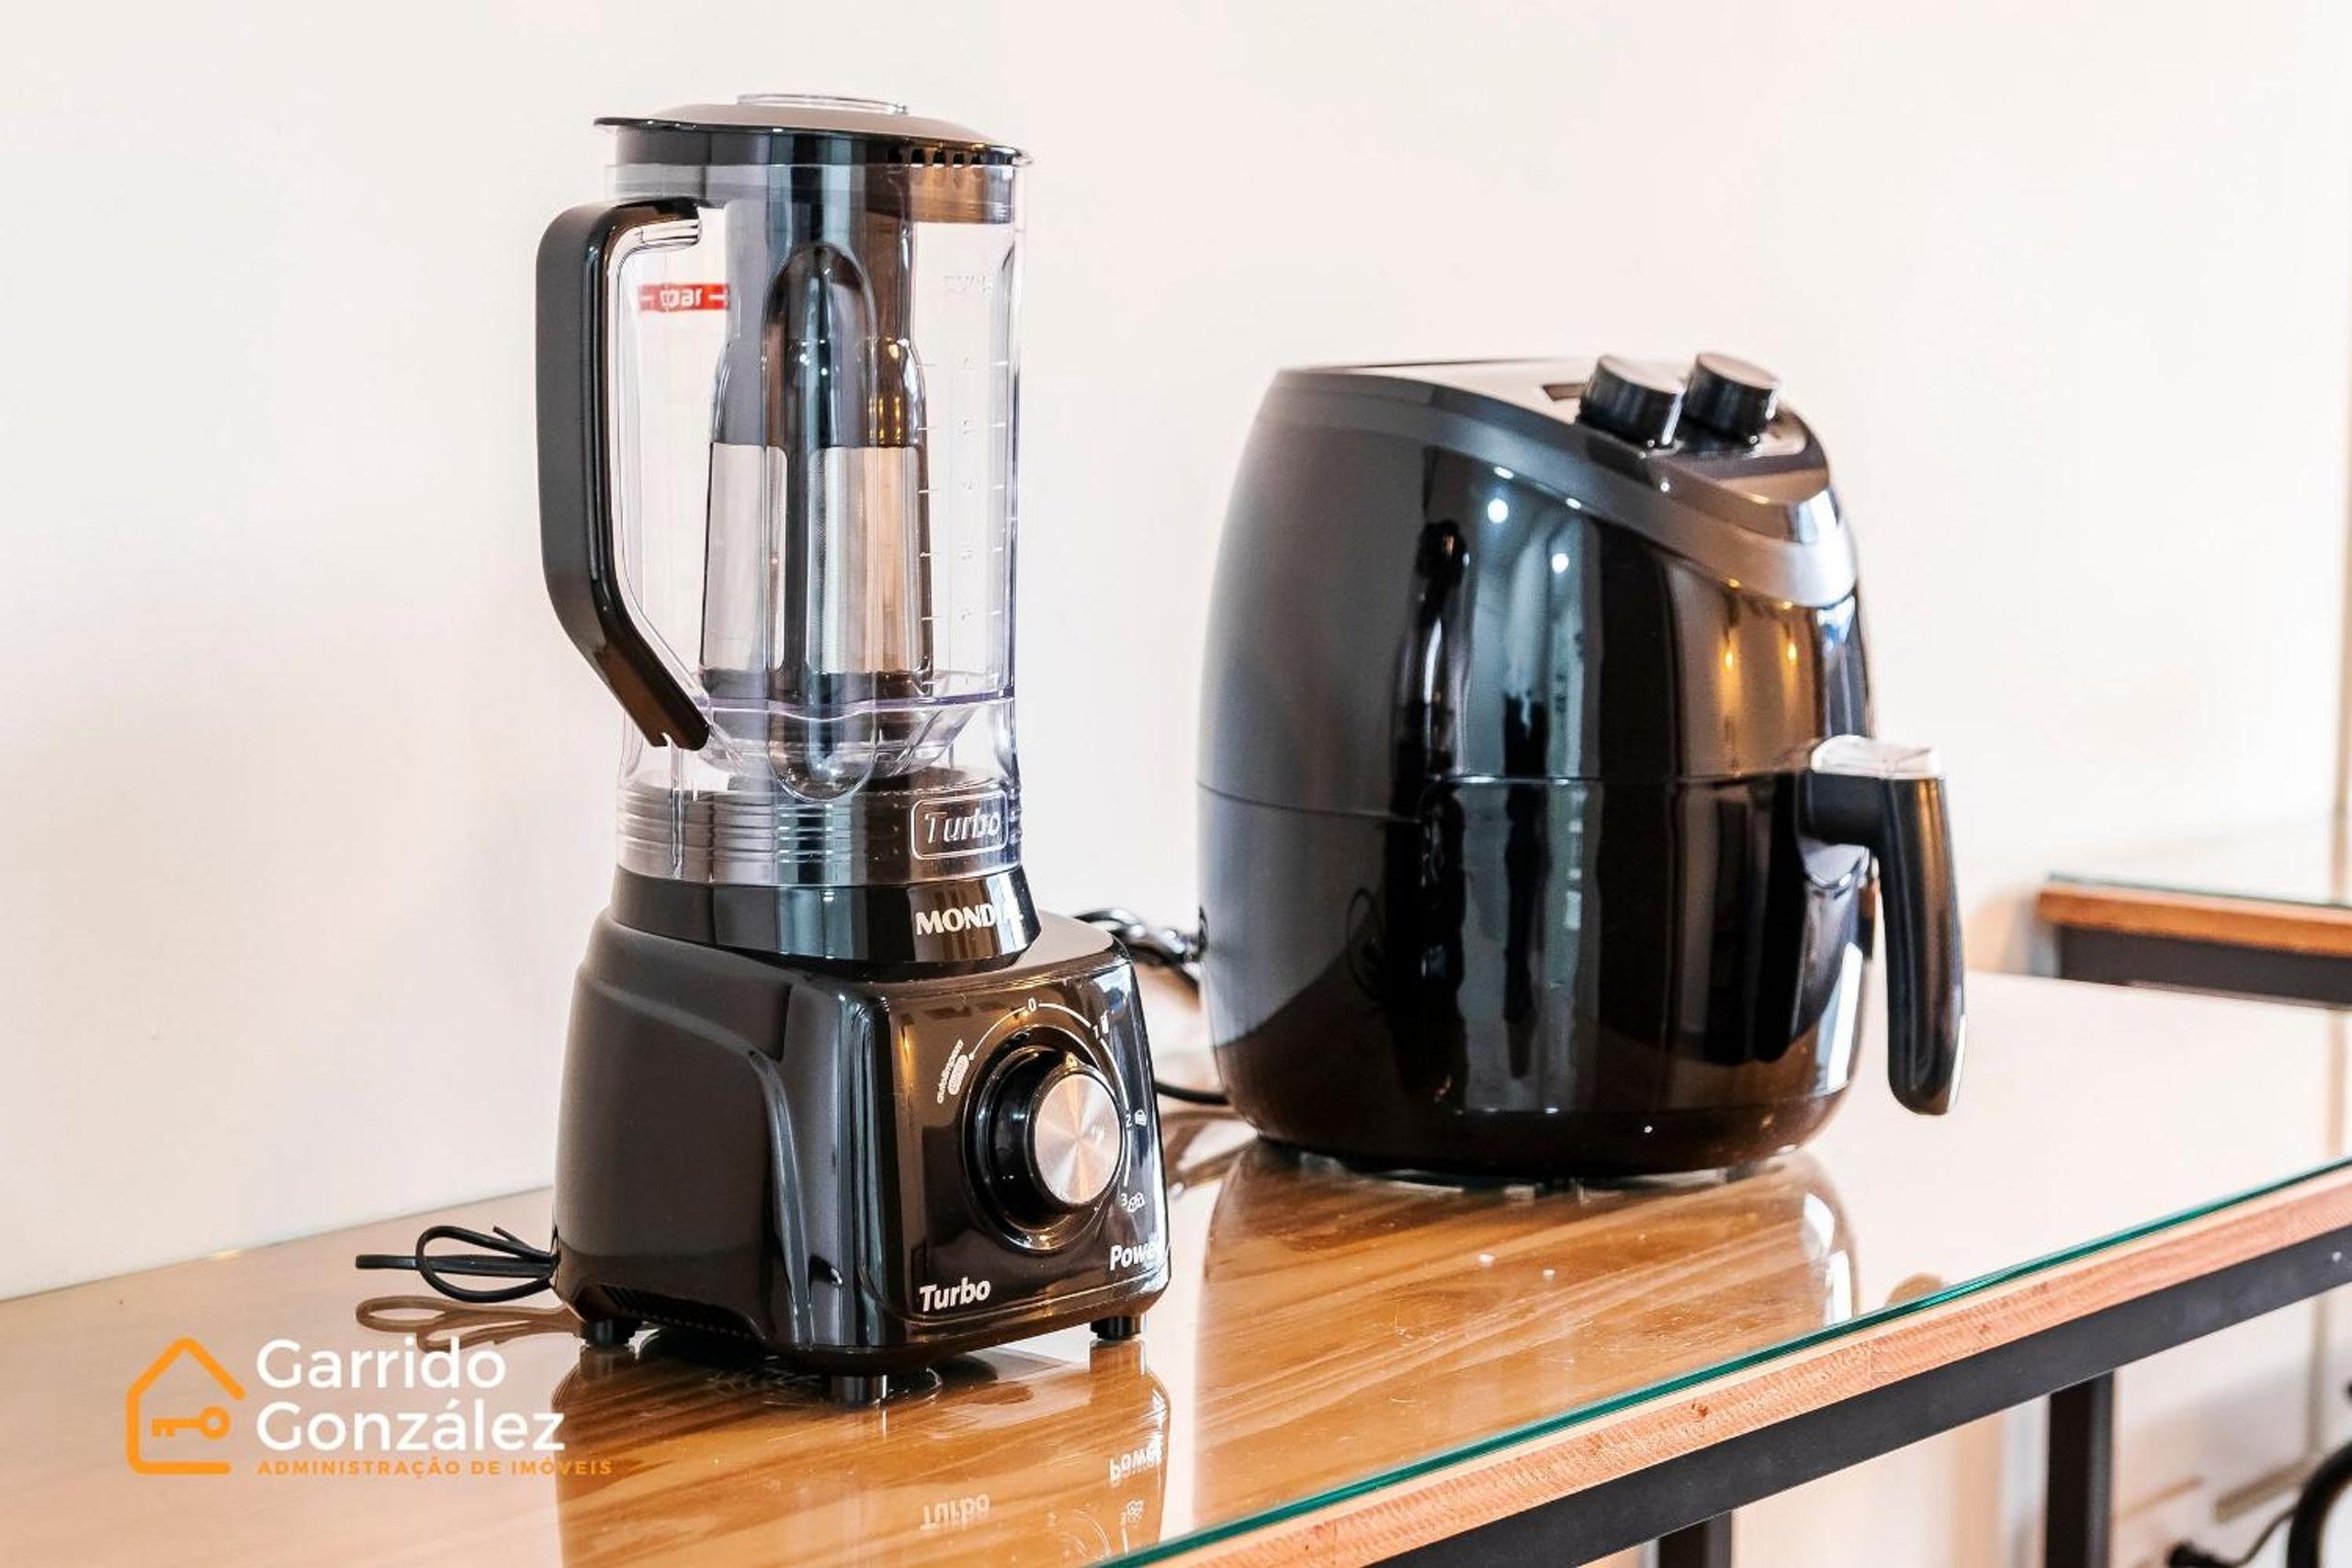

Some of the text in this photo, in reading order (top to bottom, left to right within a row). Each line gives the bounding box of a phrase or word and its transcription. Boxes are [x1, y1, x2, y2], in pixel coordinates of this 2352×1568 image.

[924, 808, 1001, 843] Turbo
[1028, 998, 1036, 1012] 0
[1125, 1113, 1132, 1128] 2
[1121, 1192, 1128, 1207] 3
[919, 1276, 990, 1312] Turbo
